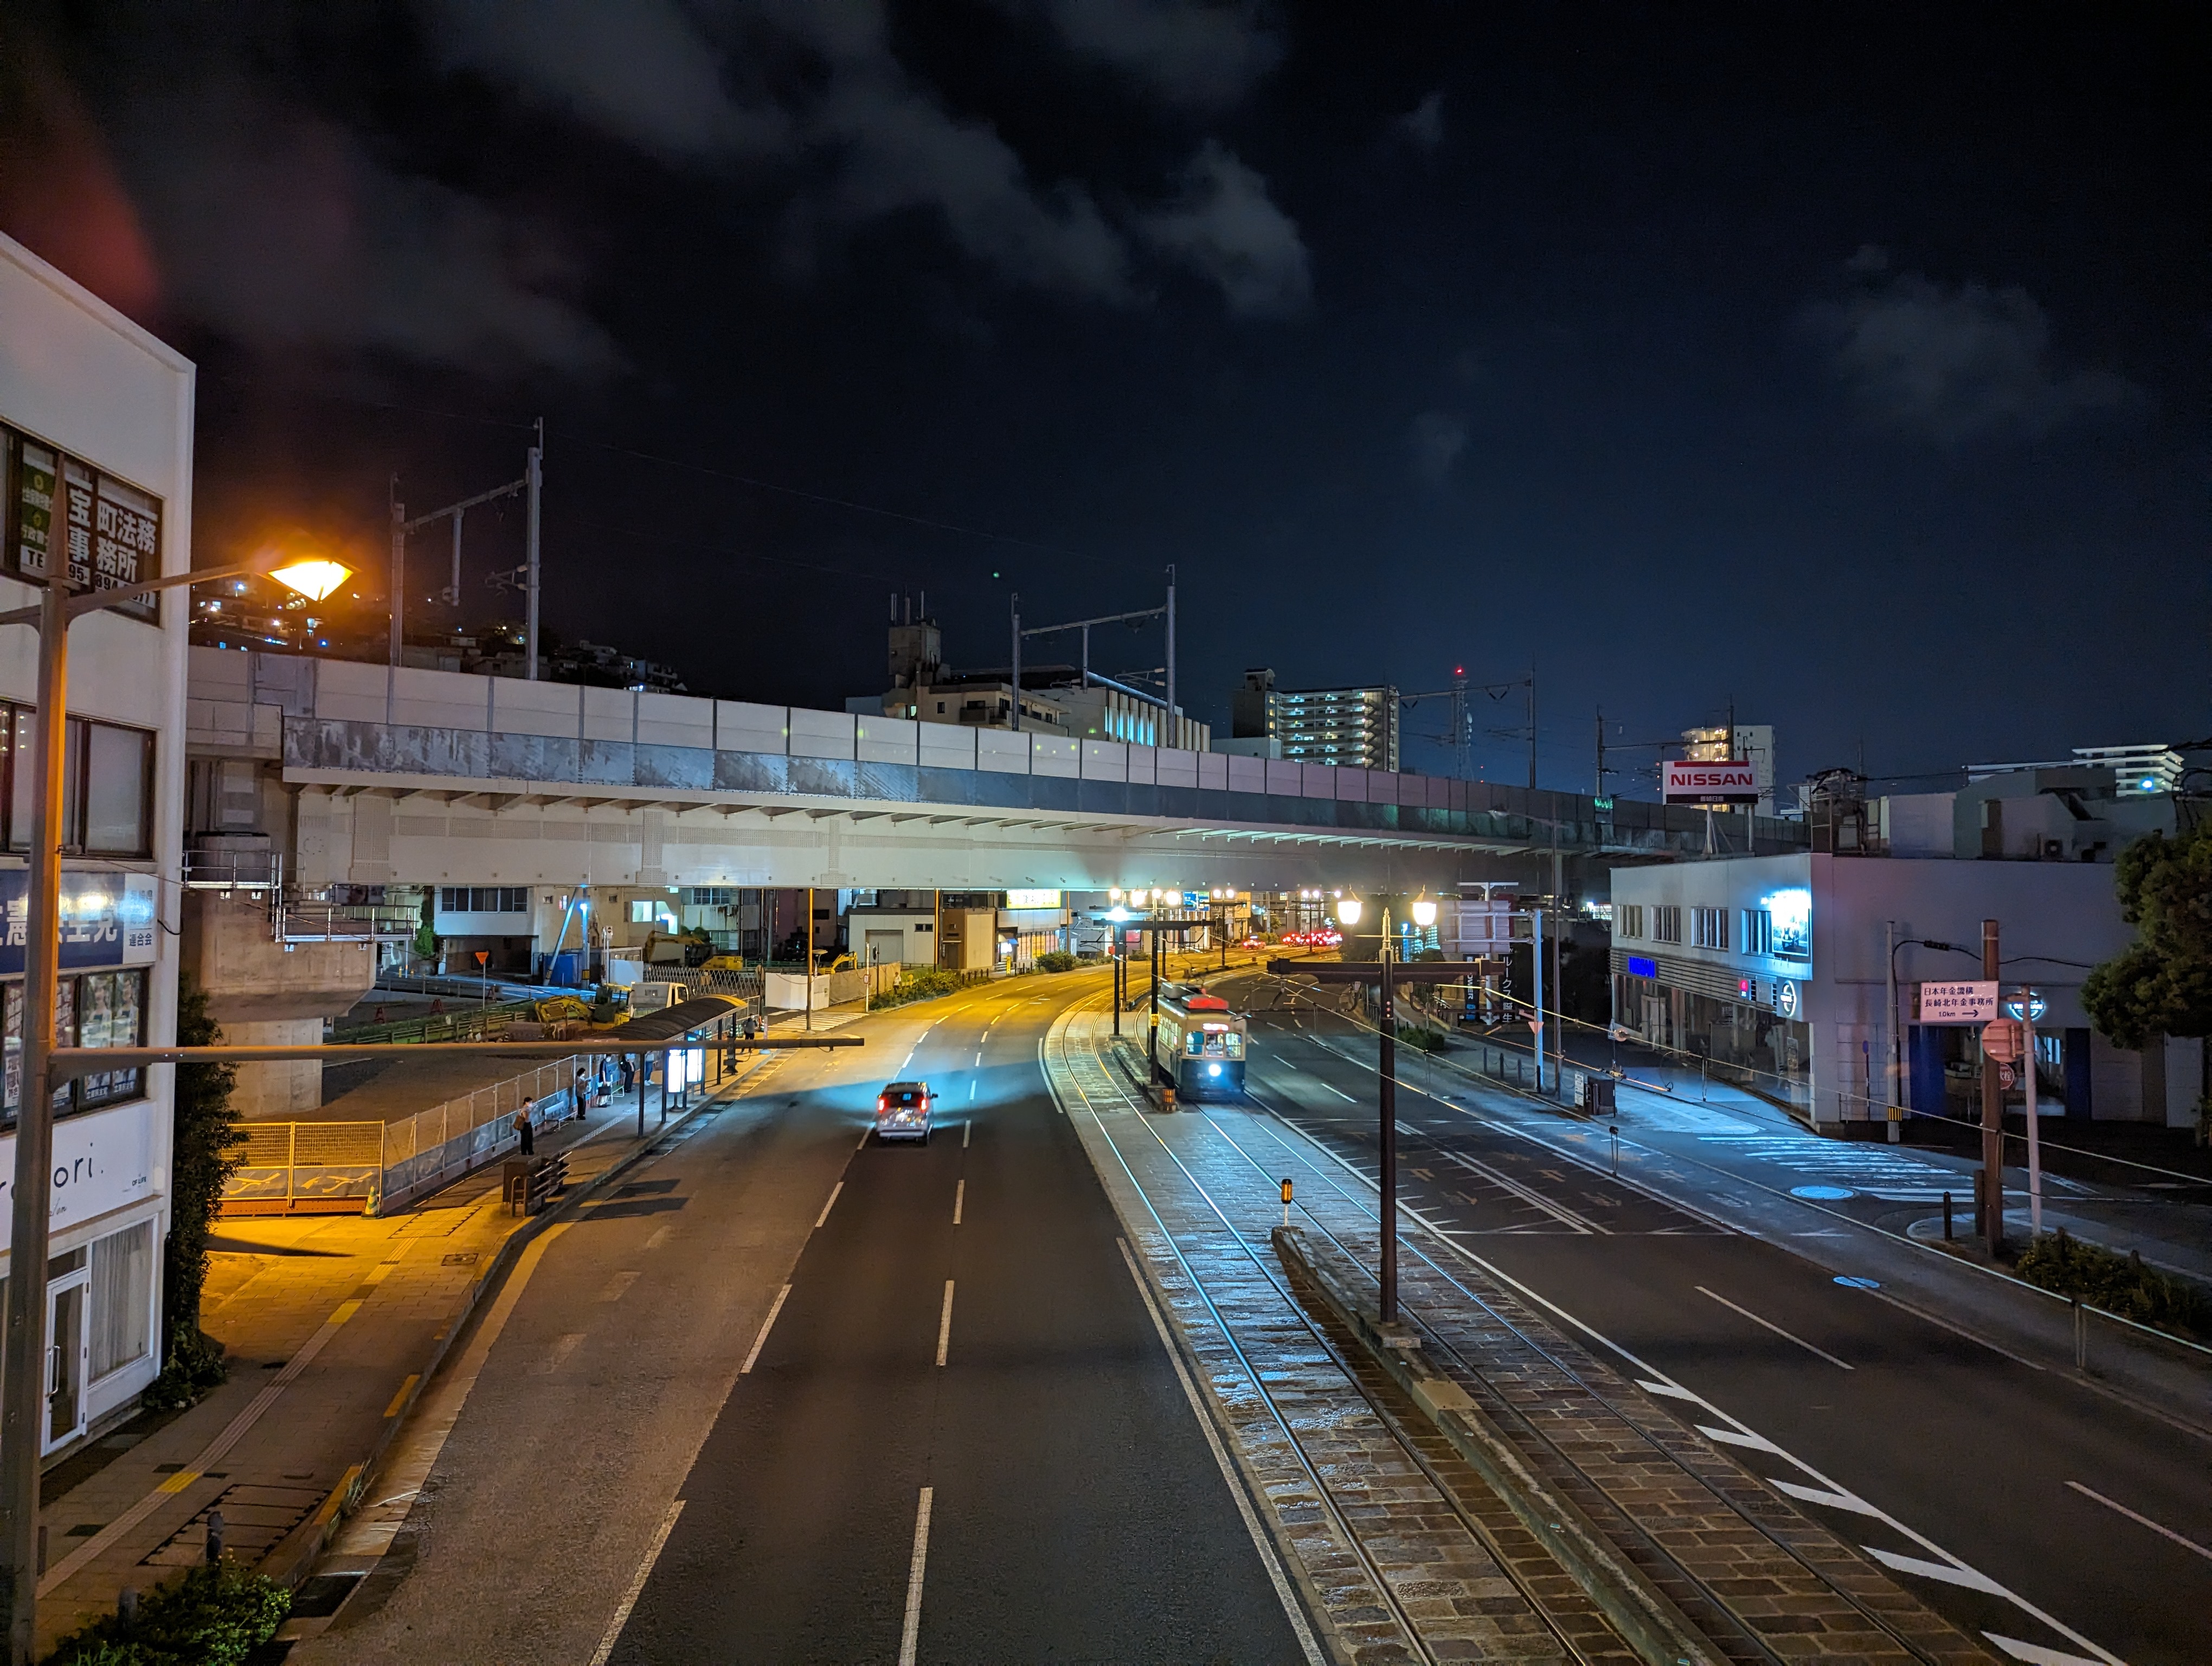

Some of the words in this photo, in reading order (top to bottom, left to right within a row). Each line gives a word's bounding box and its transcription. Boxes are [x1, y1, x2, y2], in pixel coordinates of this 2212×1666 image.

[28, 549, 44, 568] TE
[1671, 773, 1753, 786] NISSAN
[1925, 986, 1973, 996] 日本年金機構
[1925, 997, 1994, 1008] 長崎北年金事務所
